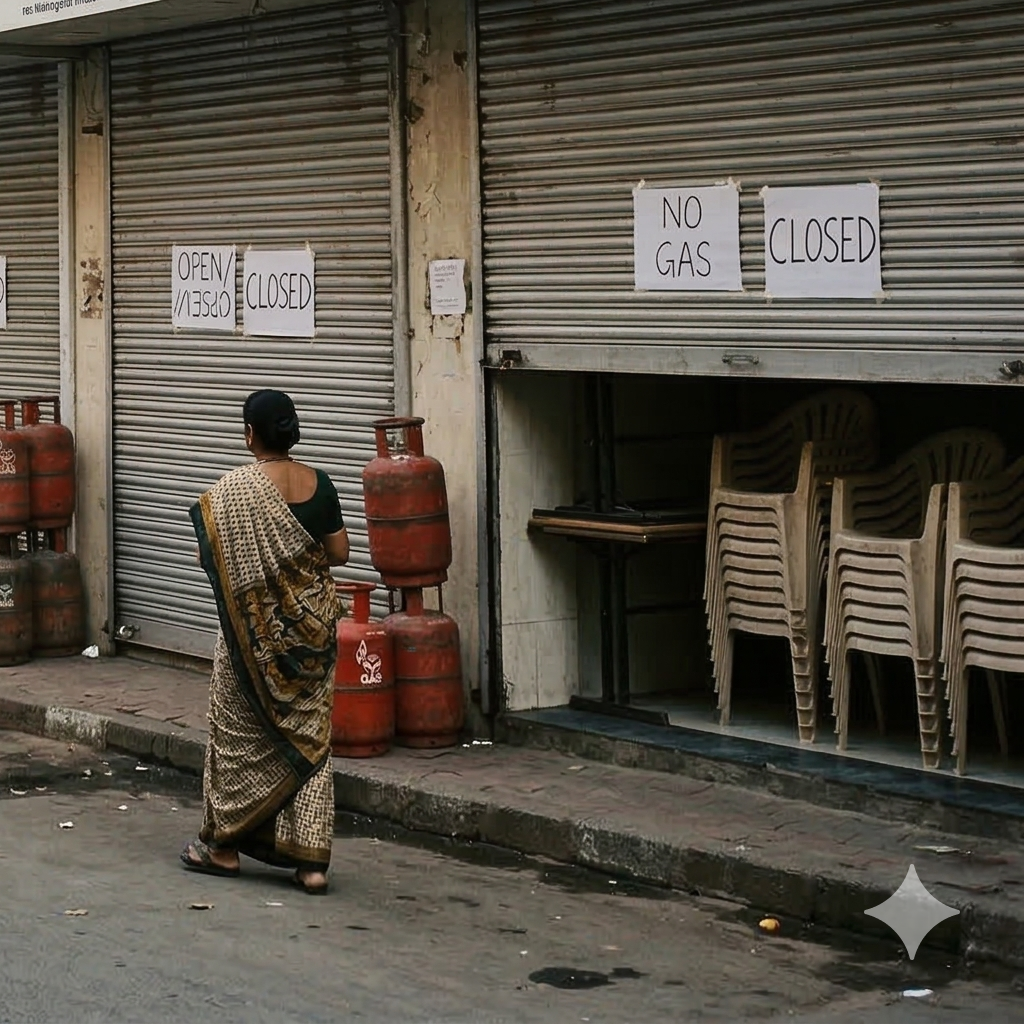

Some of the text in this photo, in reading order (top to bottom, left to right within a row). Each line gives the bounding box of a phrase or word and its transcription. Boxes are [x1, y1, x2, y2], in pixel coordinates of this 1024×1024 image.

[662, 195, 702, 229] NO
[769, 216, 876, 265] CLOSED
[178, 251, 233, 288] OPEN/
[655, 241, 711, 278] GAS
[246, 272, 312, 310] CLOSED
